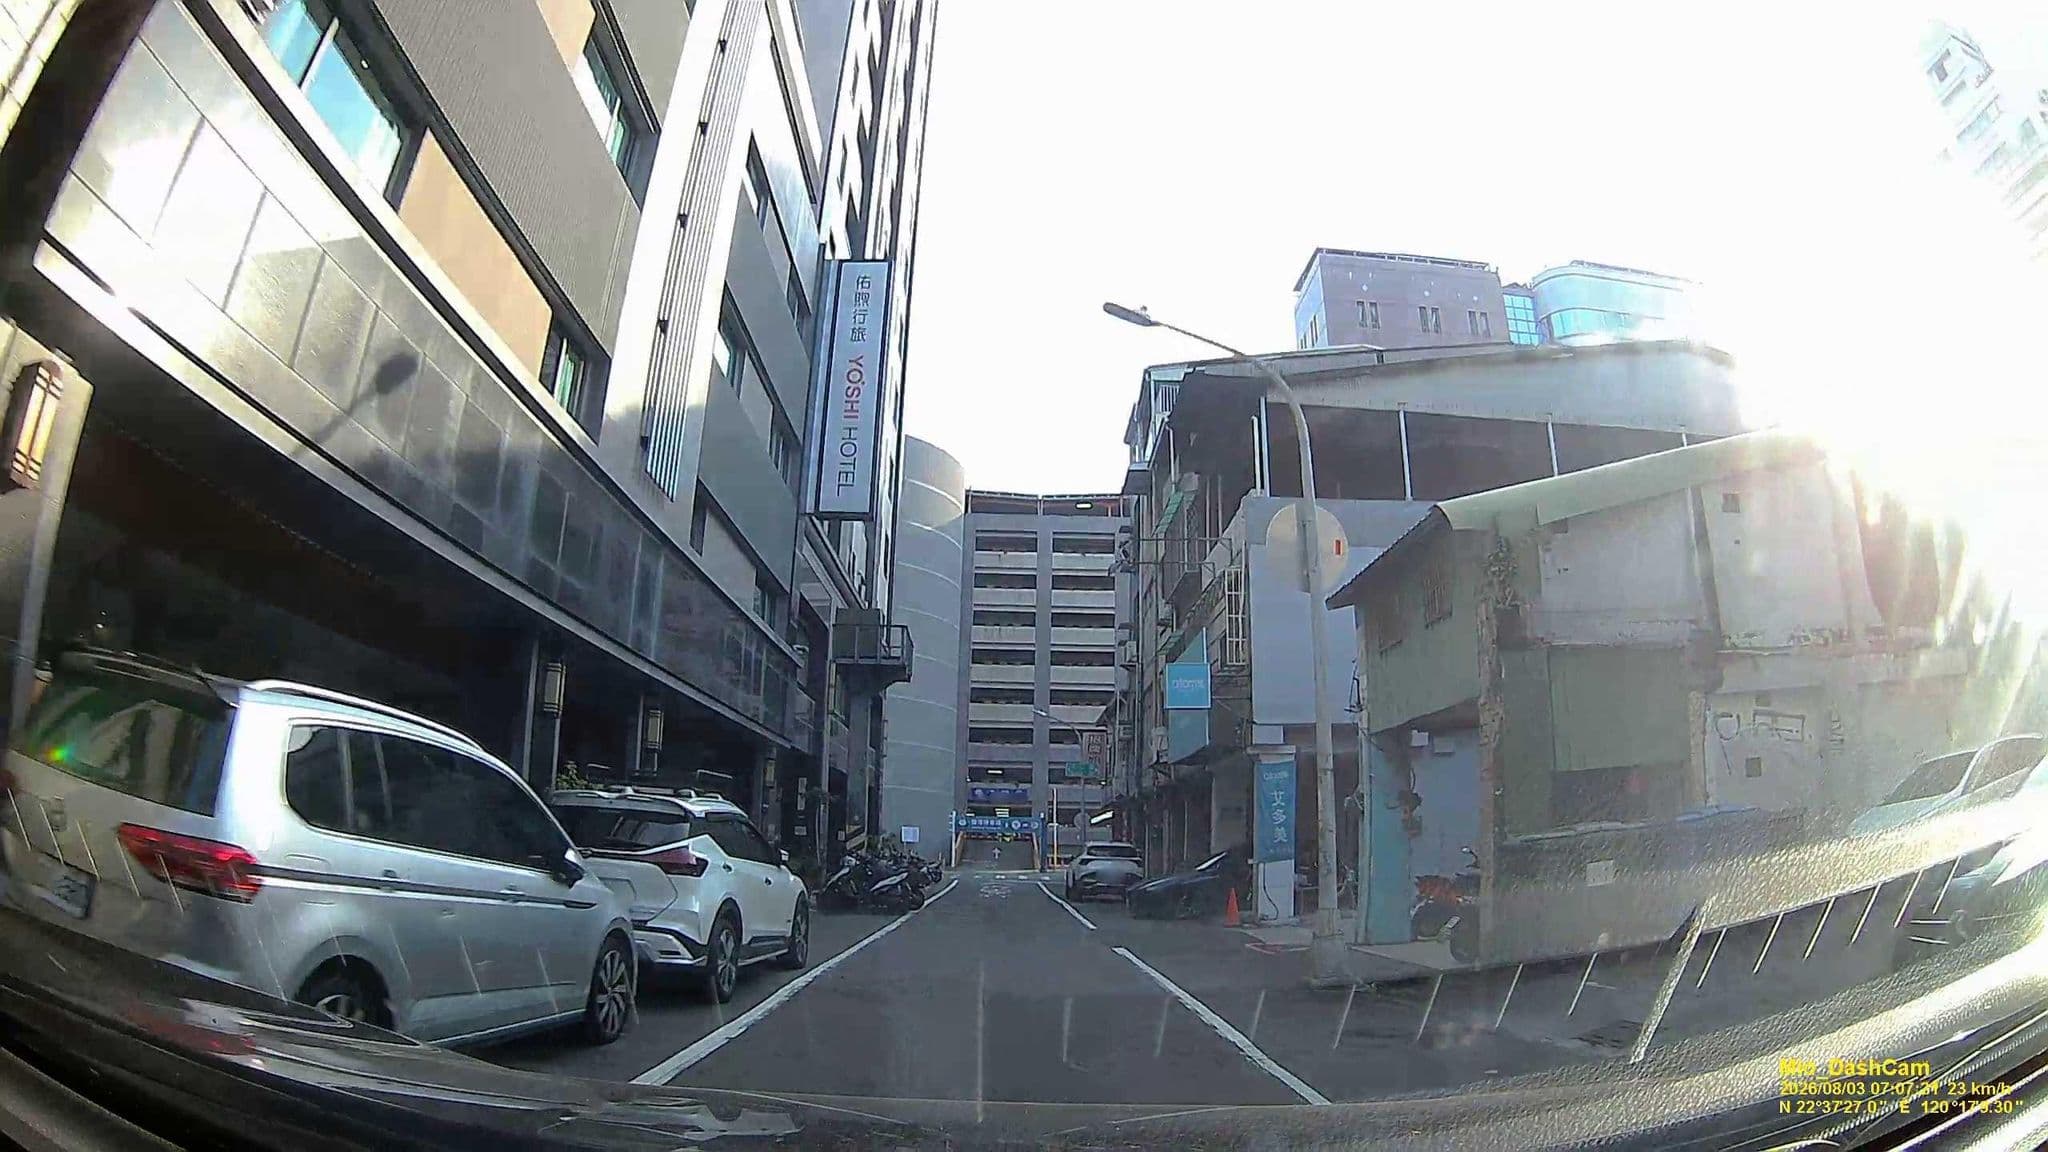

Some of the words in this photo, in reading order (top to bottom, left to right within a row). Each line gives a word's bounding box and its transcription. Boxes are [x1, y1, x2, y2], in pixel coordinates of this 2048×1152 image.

[837, 426, 858, 497] HOTEL
[1271, 790, 1288, 843] 艾多美
